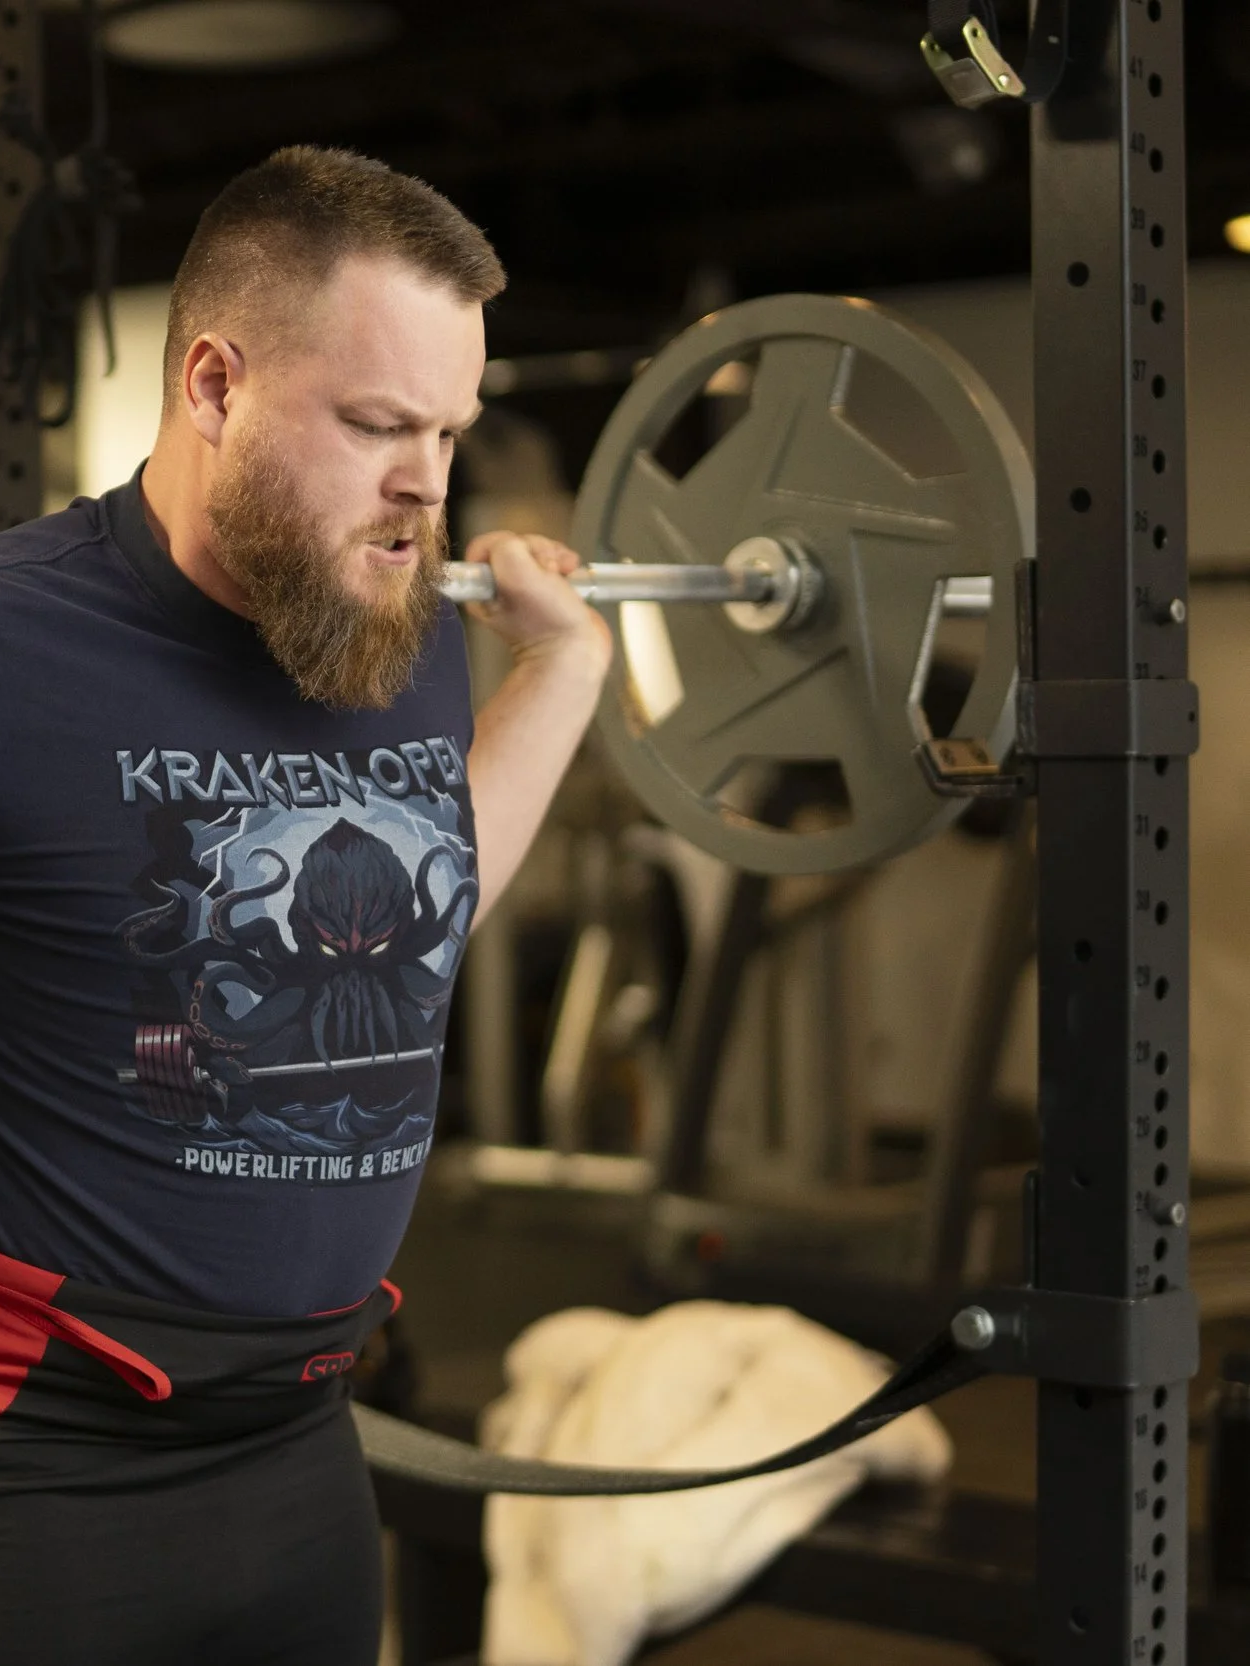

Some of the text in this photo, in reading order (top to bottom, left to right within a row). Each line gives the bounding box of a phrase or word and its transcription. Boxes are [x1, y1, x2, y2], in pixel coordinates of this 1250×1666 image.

[1132, 359, 1146, 382] 37
[1133, 434, 1147, 457] 36
[116, 735, 467, 808] KRAKEN OPEN
[1135, 814, 1149, 836] 31
[359, 1153, 375, 1178] &
[380, 1142, 424, 1175] BENCH
